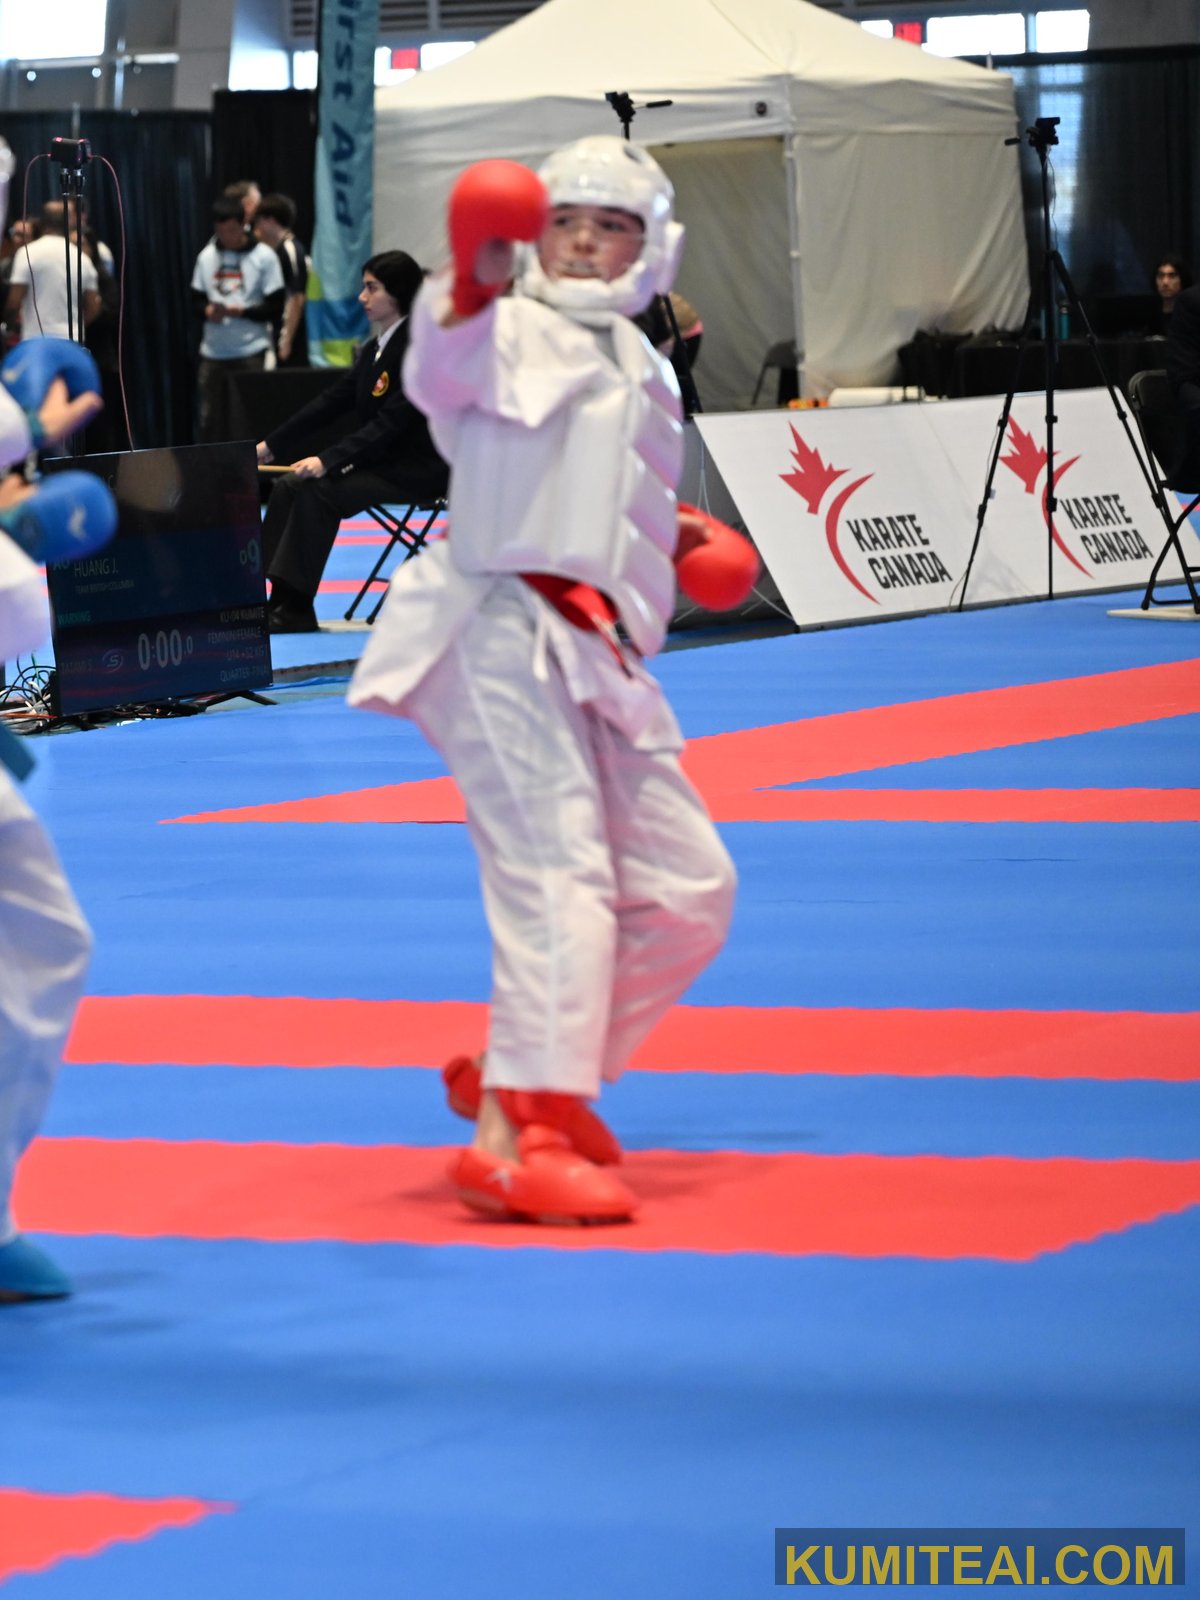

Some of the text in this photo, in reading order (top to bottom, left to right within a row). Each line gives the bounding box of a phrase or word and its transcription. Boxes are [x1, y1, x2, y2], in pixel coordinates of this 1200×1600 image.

[332, 0, 362, 227] irst Aid
[1060, 494, 1133, 530] KARATE
[846, 514, 930, 552] KARATE
[1080, 529, 1154, 565] CANADA
[74, 557, 110, 578] HUANG
[111, 555, 119, 574] J.
[867, 551, 953, 589] CANADA
[240, 606, 265, 620] KUMITE
